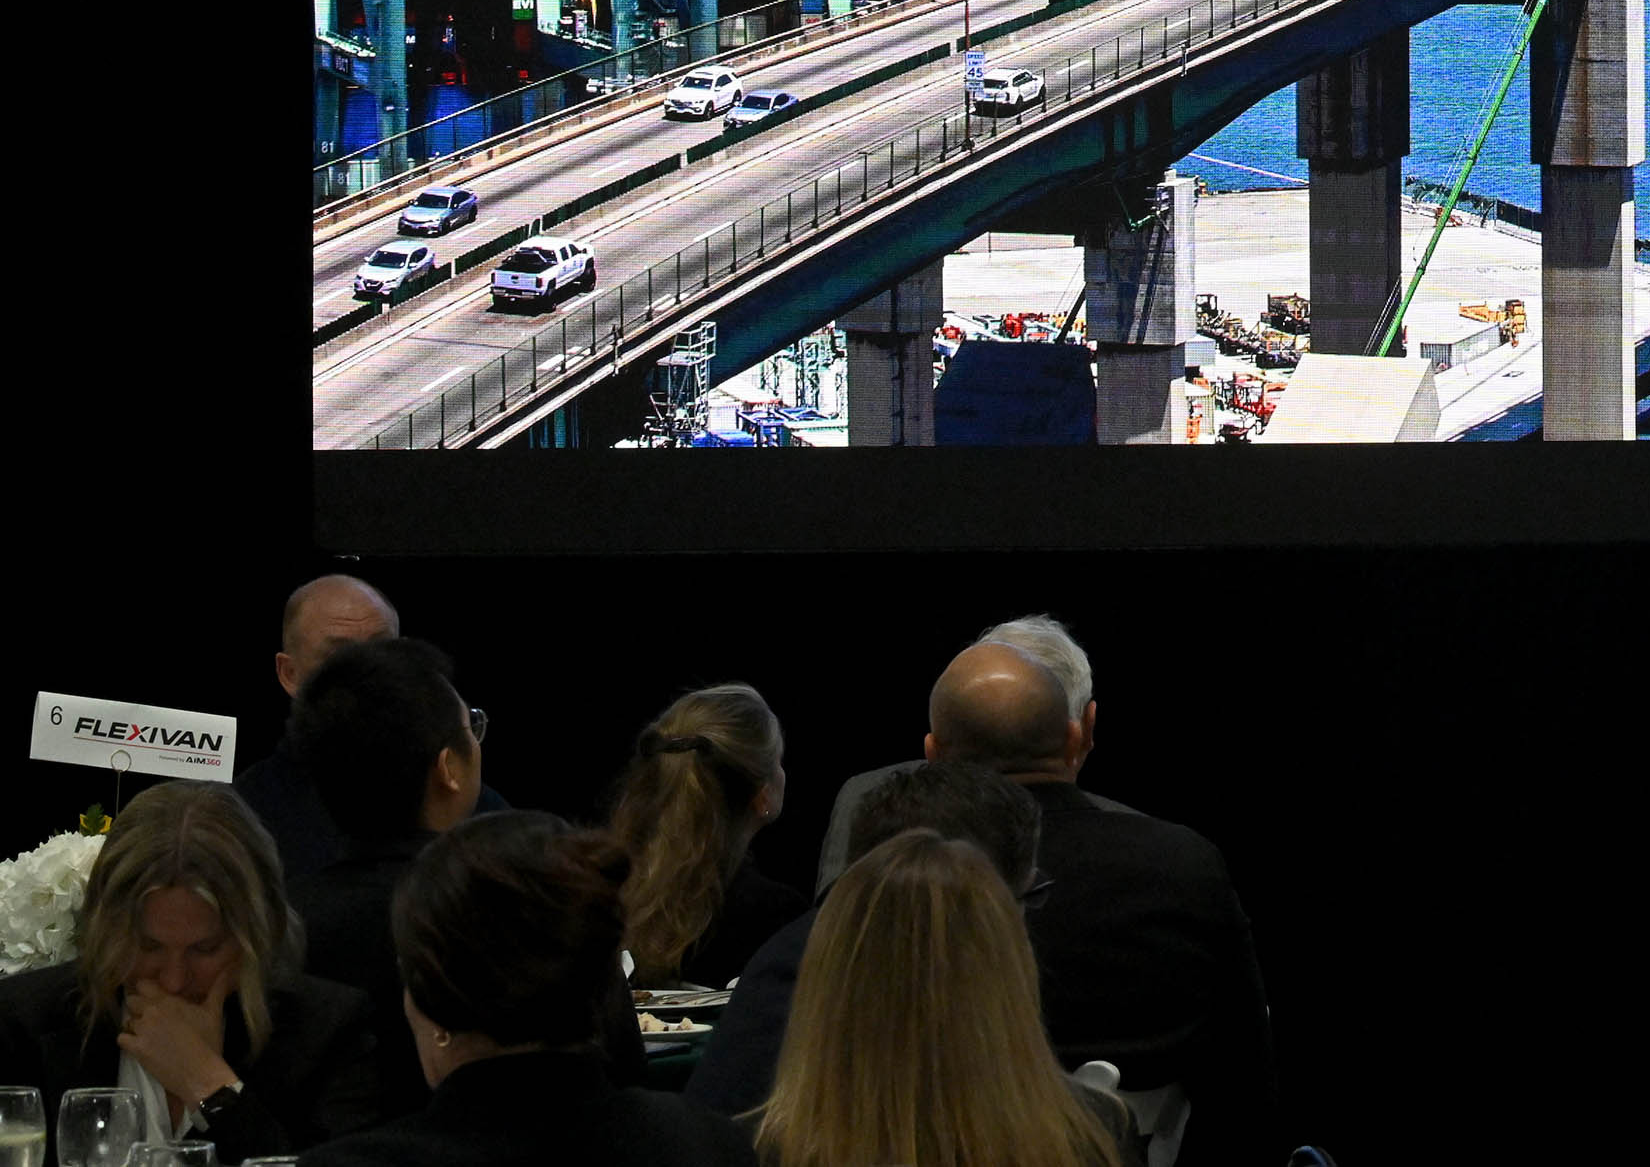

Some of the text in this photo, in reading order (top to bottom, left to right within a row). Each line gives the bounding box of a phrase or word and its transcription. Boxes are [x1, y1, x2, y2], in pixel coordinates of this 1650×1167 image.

[967, 67, 984, 78] 45
[50, 705, 63, 725] 6
[74, 717, 223, 752] FLEXIVAN
